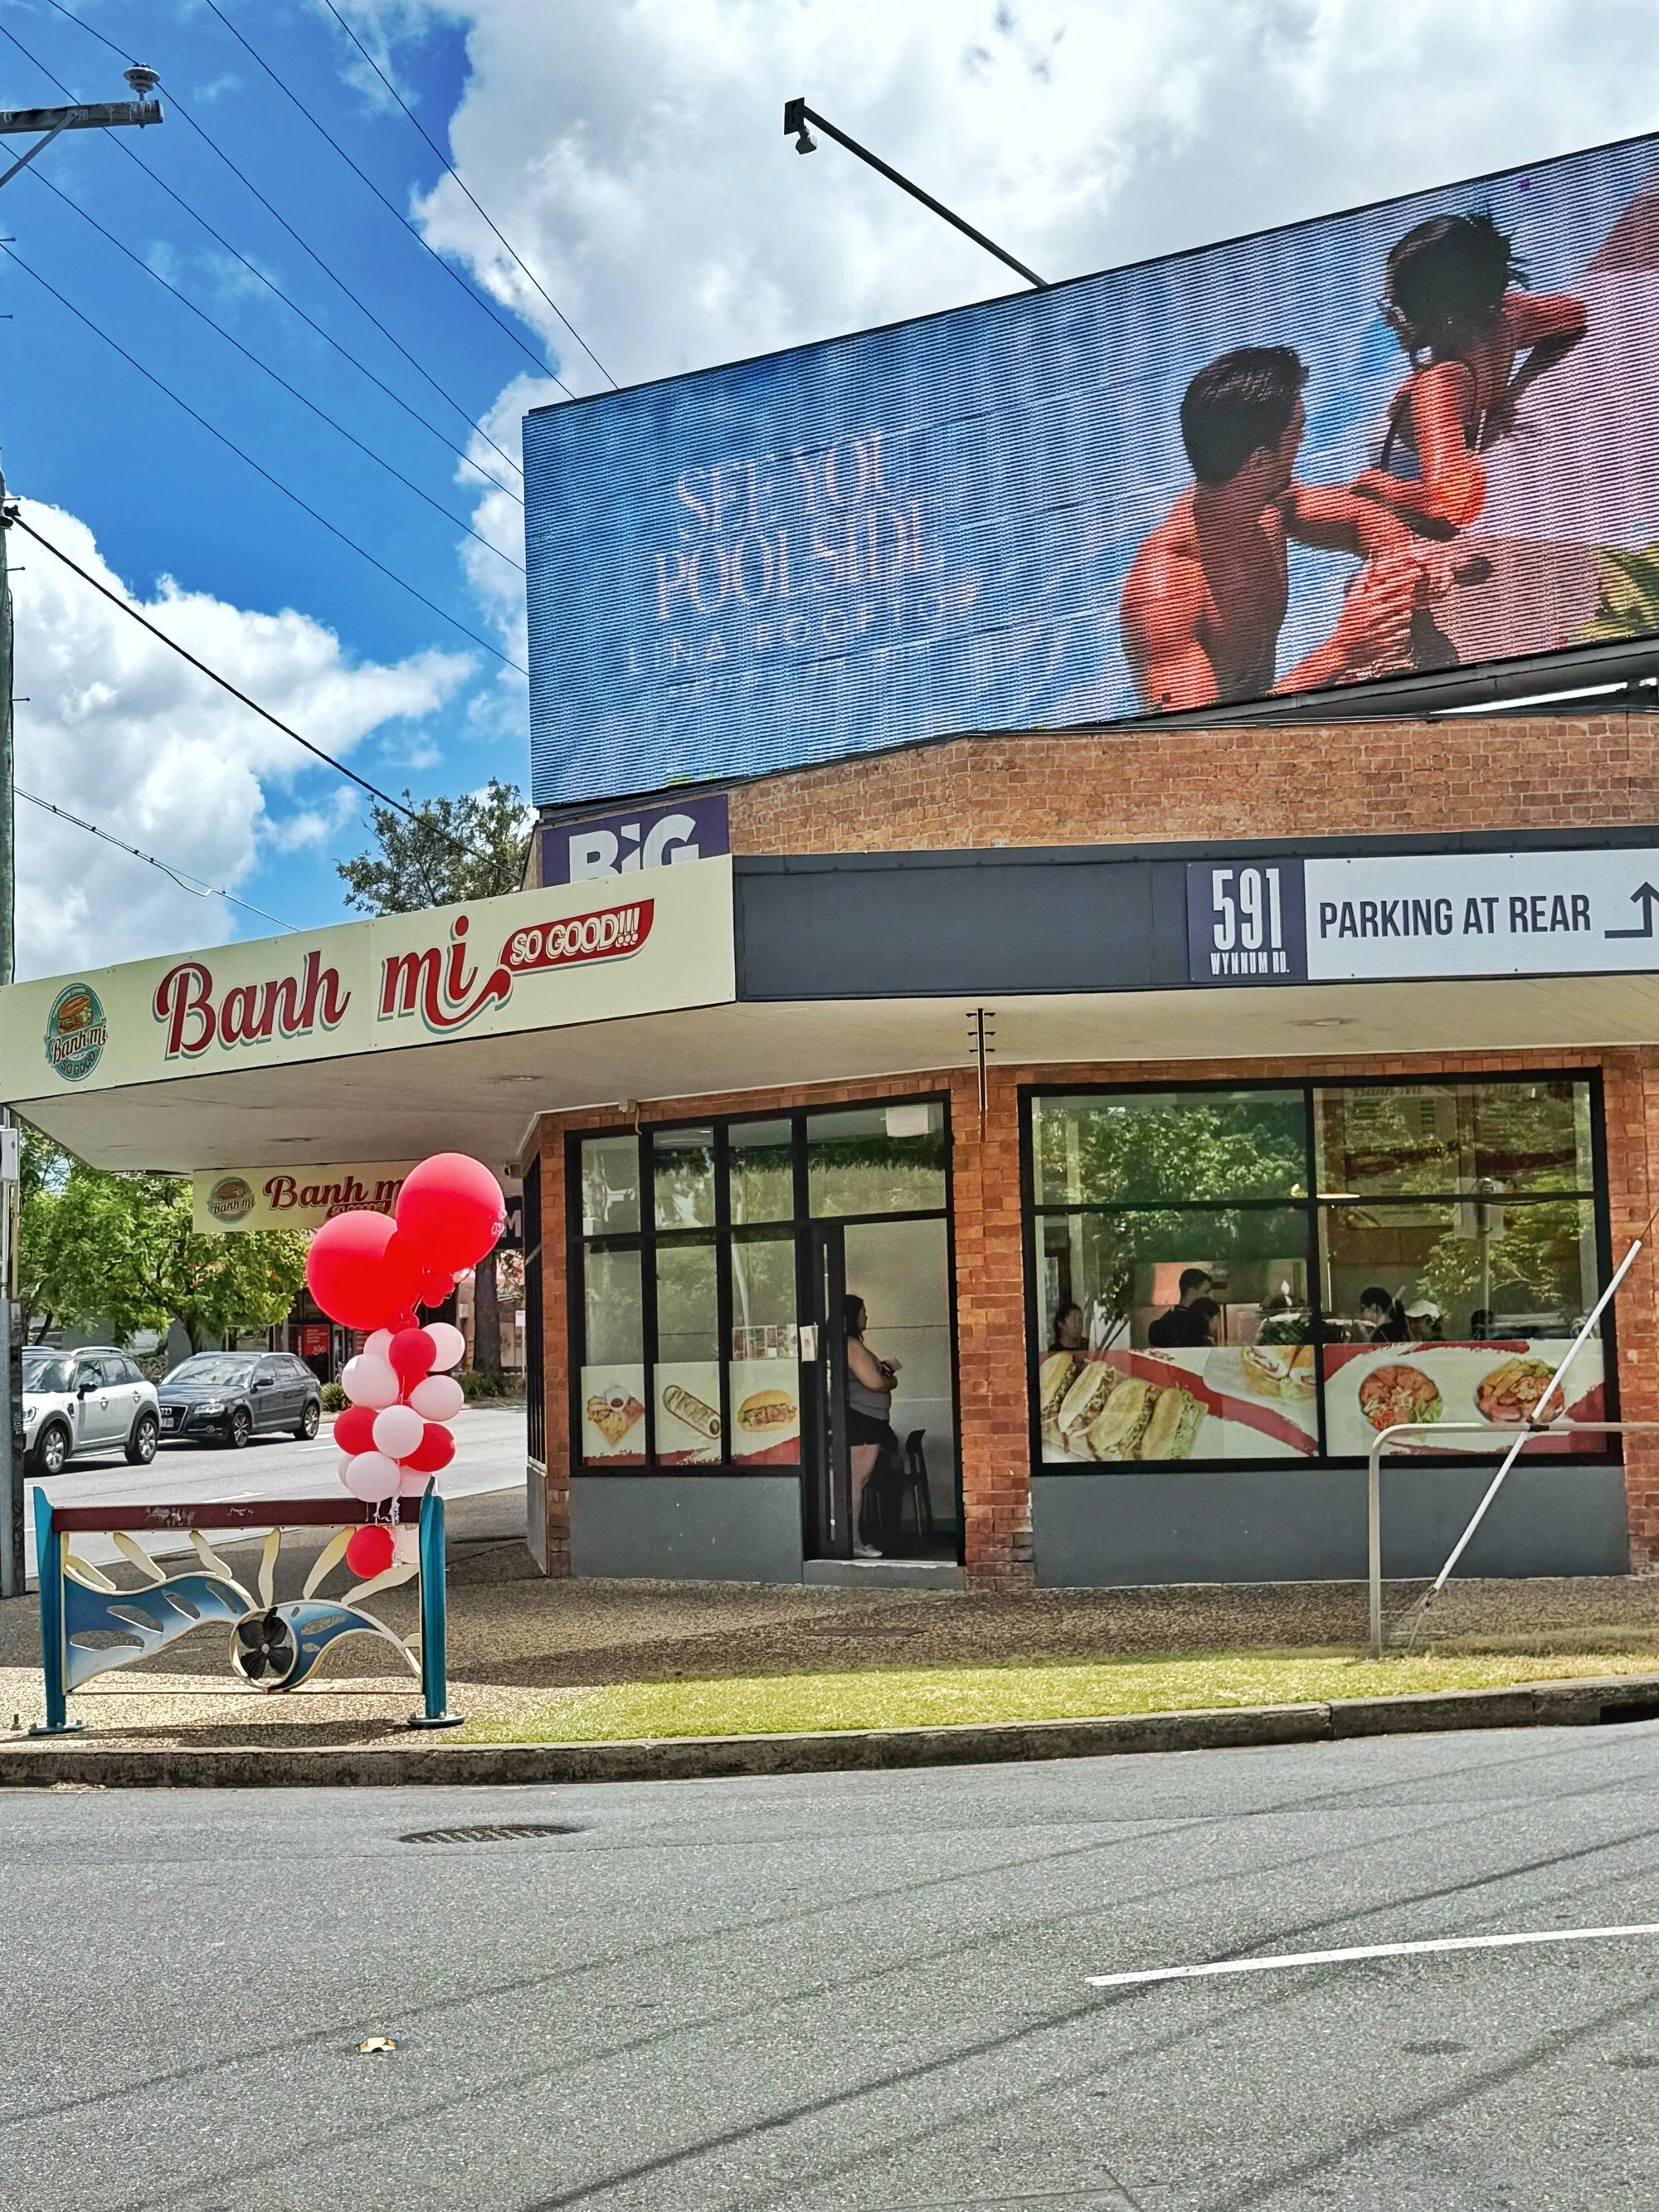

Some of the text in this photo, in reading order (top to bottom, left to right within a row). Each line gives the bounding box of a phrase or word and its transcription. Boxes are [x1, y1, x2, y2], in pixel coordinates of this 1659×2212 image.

[793, 426, 909, 516] YOU
[1212, 868, 1282, 950] 591
[1320, 894, 1592, 938] PARKING AT REAR
[510, 907, 640, 965] SO GOOD!!!
[152, 915, 513, 1060] Banh mi
[1209, 952, 1268, 975] WYNNUM
[51, 1030, 87, 1065] Banh
[262, 1176, 369, 1211] Banh
